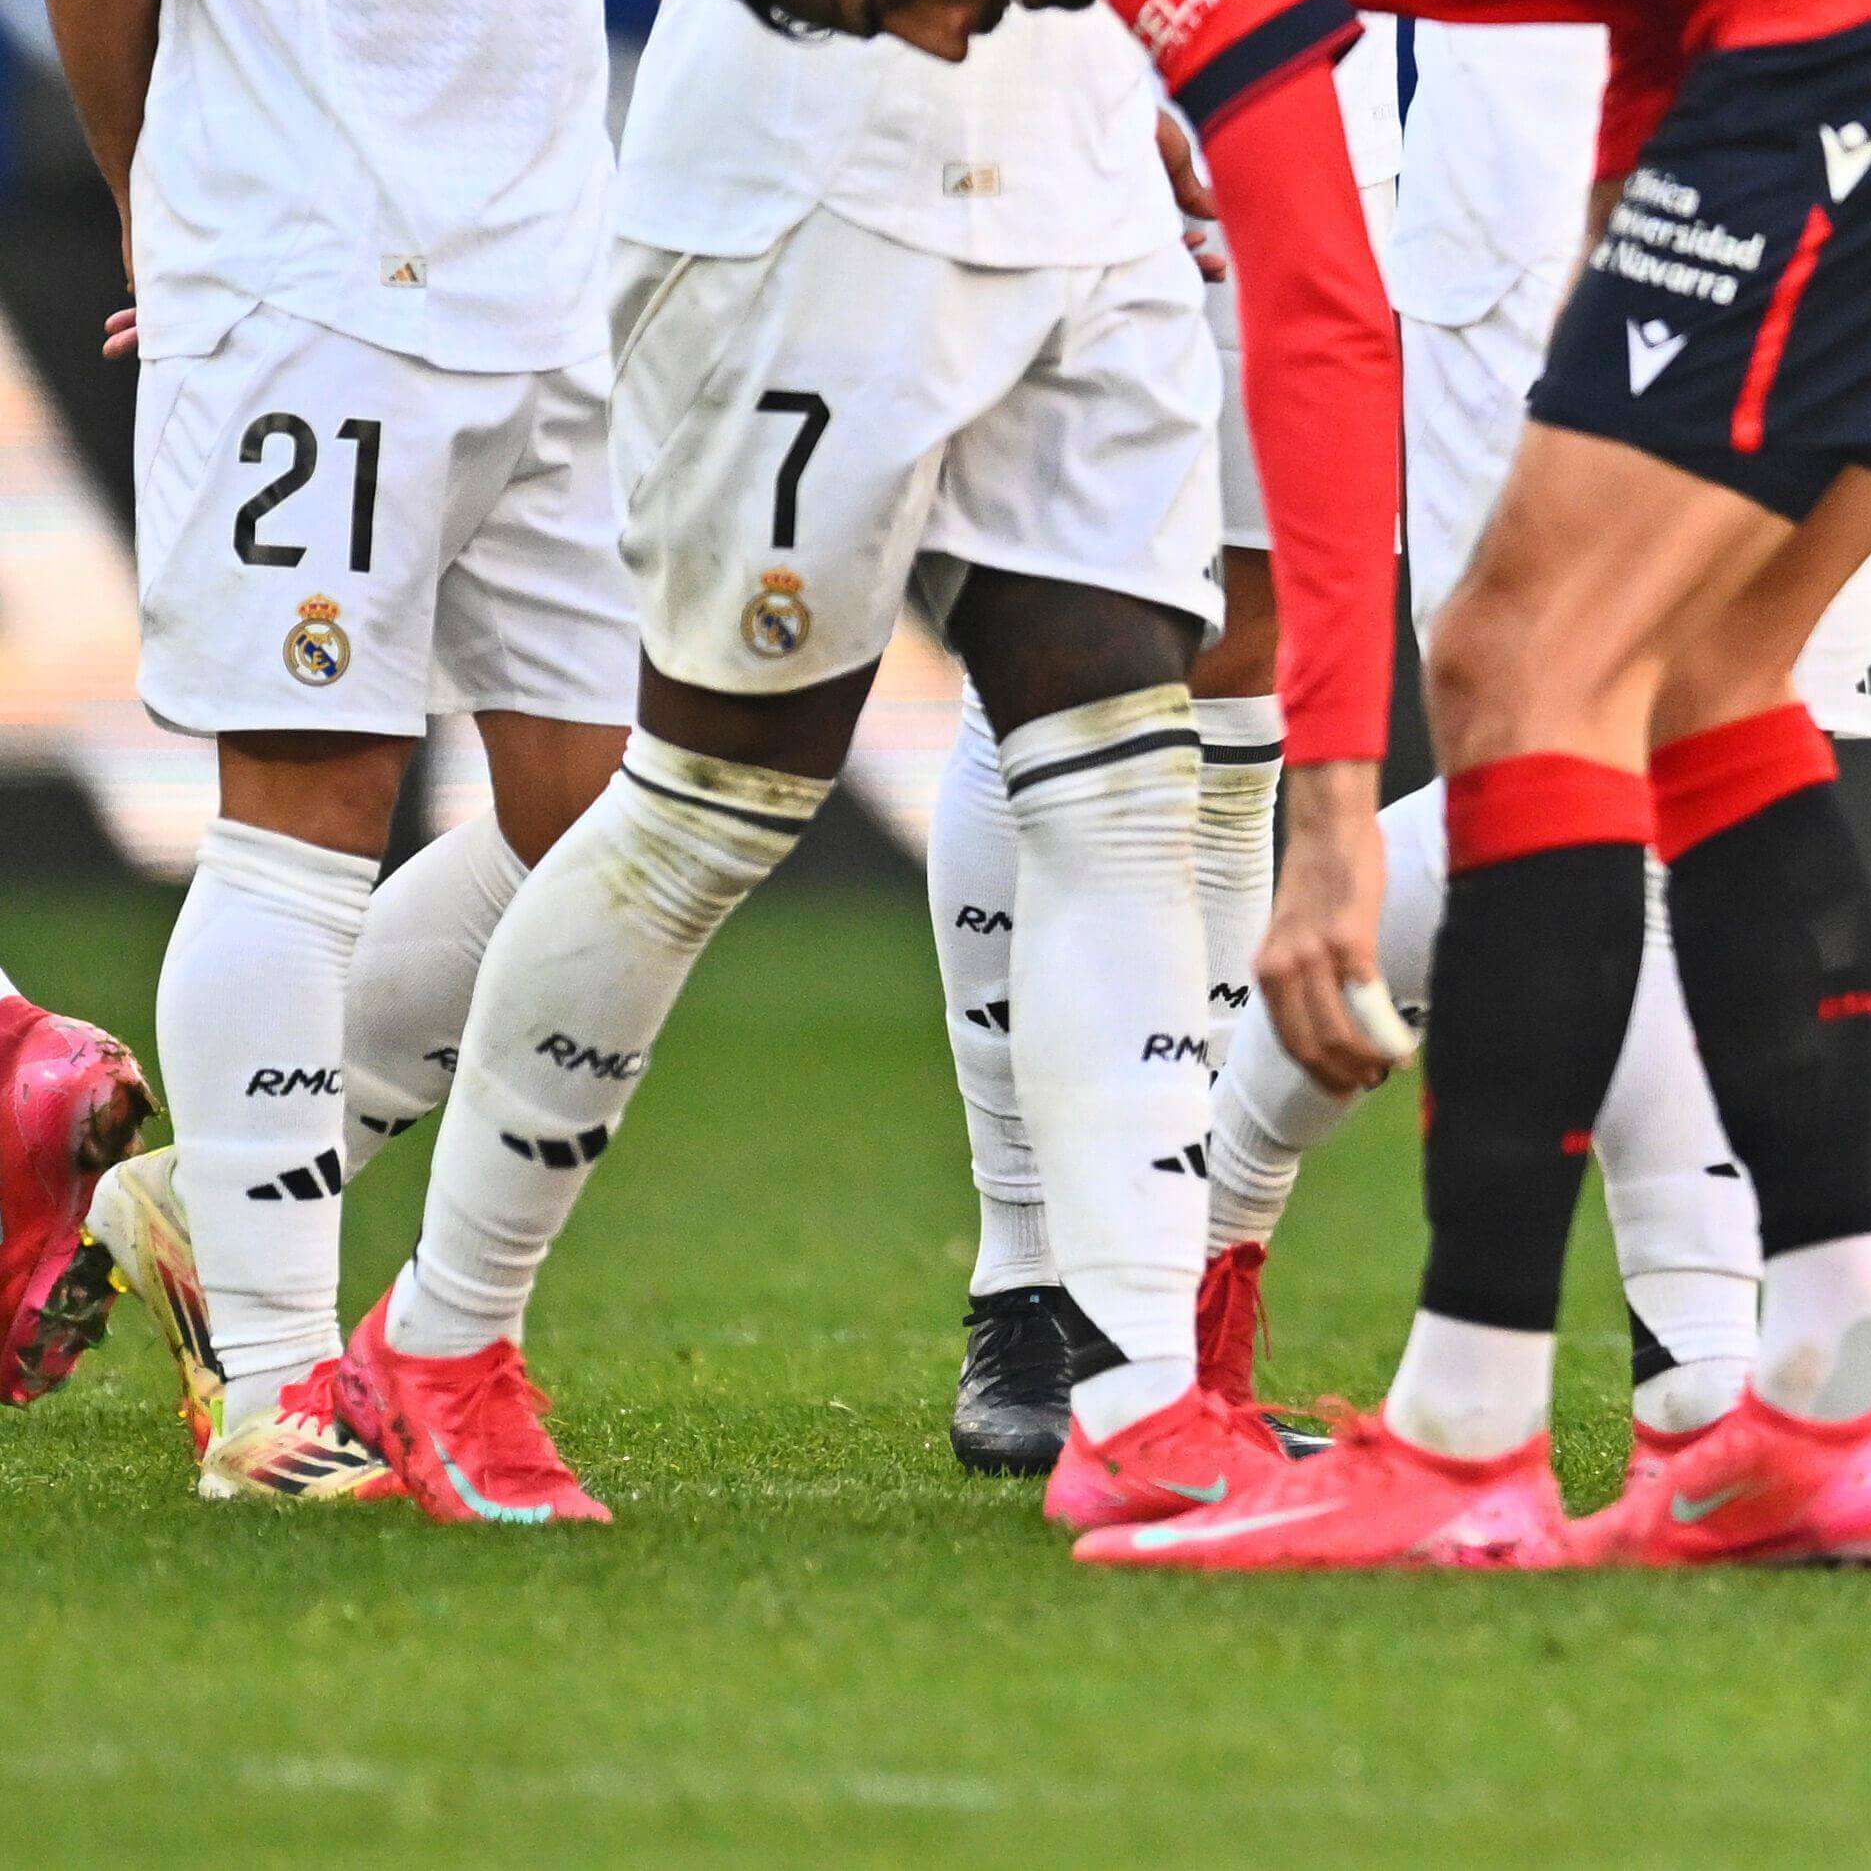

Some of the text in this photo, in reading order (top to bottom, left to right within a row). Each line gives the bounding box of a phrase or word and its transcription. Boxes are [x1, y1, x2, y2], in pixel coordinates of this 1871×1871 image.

[232, 411, 382, 574] 21
[755, 389, 832, 549] 7
[245, 1067, 343, 1097] RMC
[535, 1032, 650, 1082] RMC
